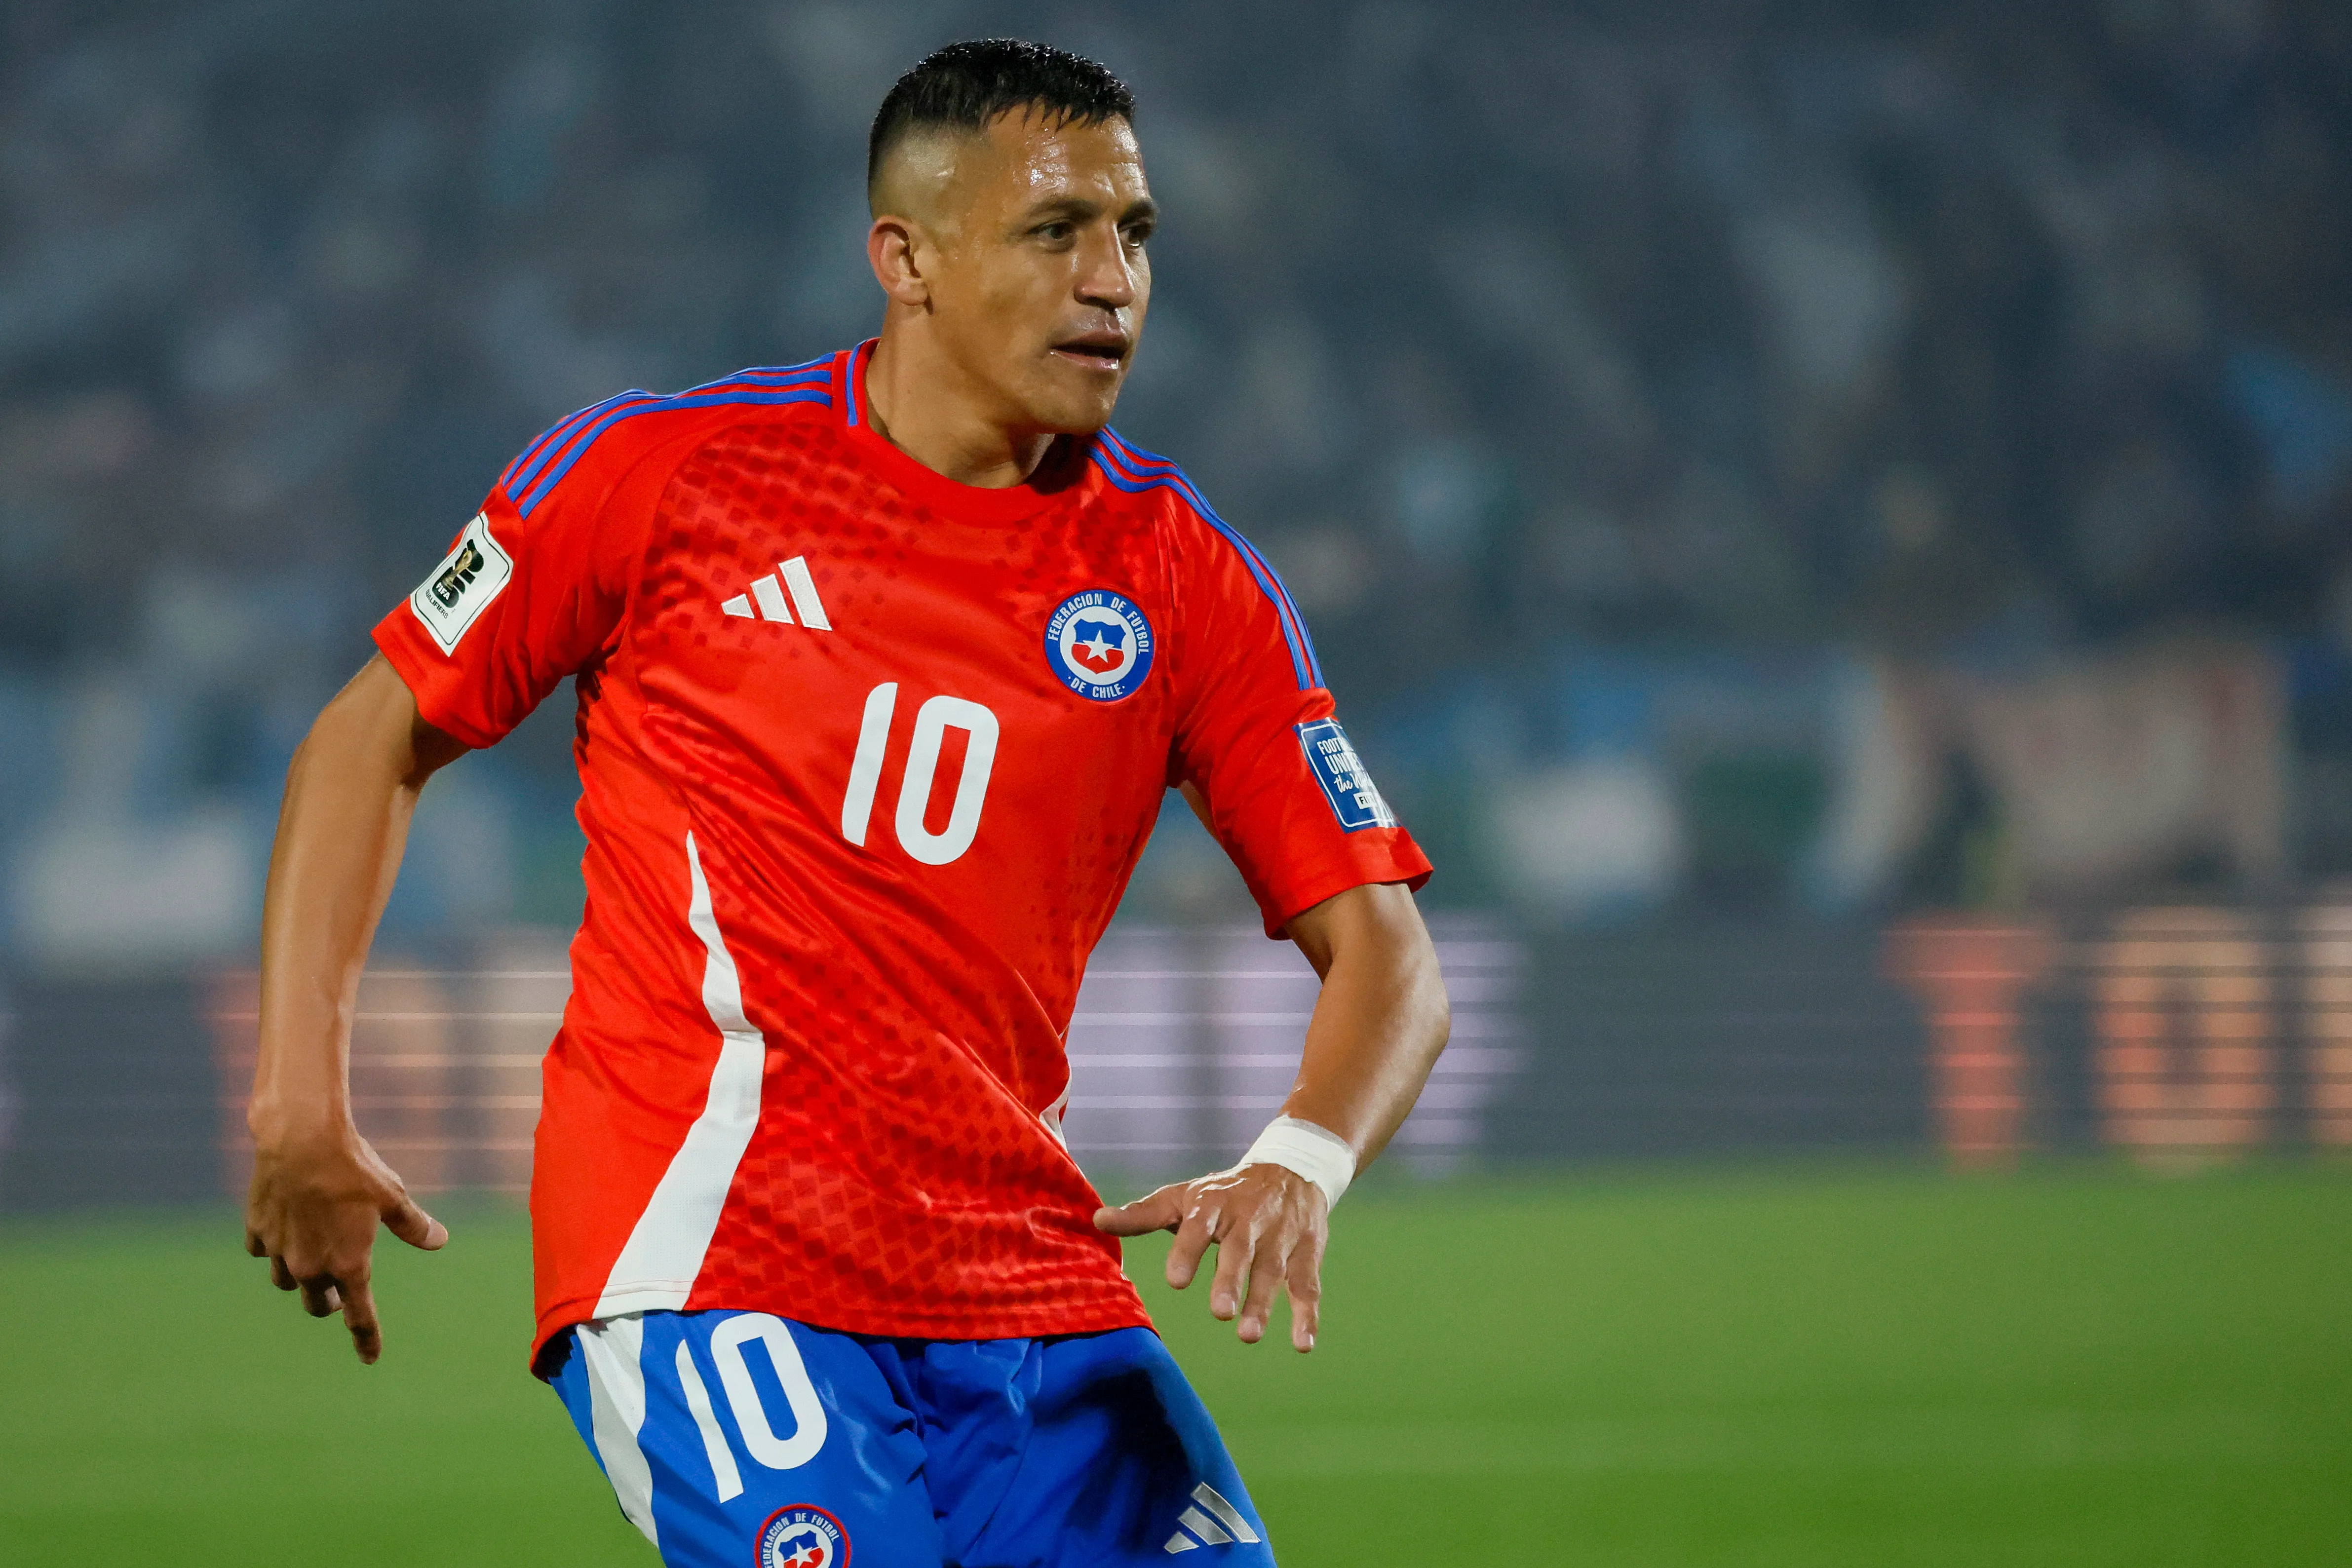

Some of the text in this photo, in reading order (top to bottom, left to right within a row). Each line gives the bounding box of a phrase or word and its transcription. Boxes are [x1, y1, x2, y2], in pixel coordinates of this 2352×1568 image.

[425, 588, 449, 619] QUALIFIERS
[436, 582, 450, 600] FIFA
[1048, 593, 1149, 654] FEDERACION DE FUTBOL
[842, 682, 1000, 865] 10
[1334, 774, 1353, 793] the
[675, 1313, 828, 1504] 10
[795, 1513, 807, 1523] DE
[811, 1515, 840, 1542] FUTBOL
